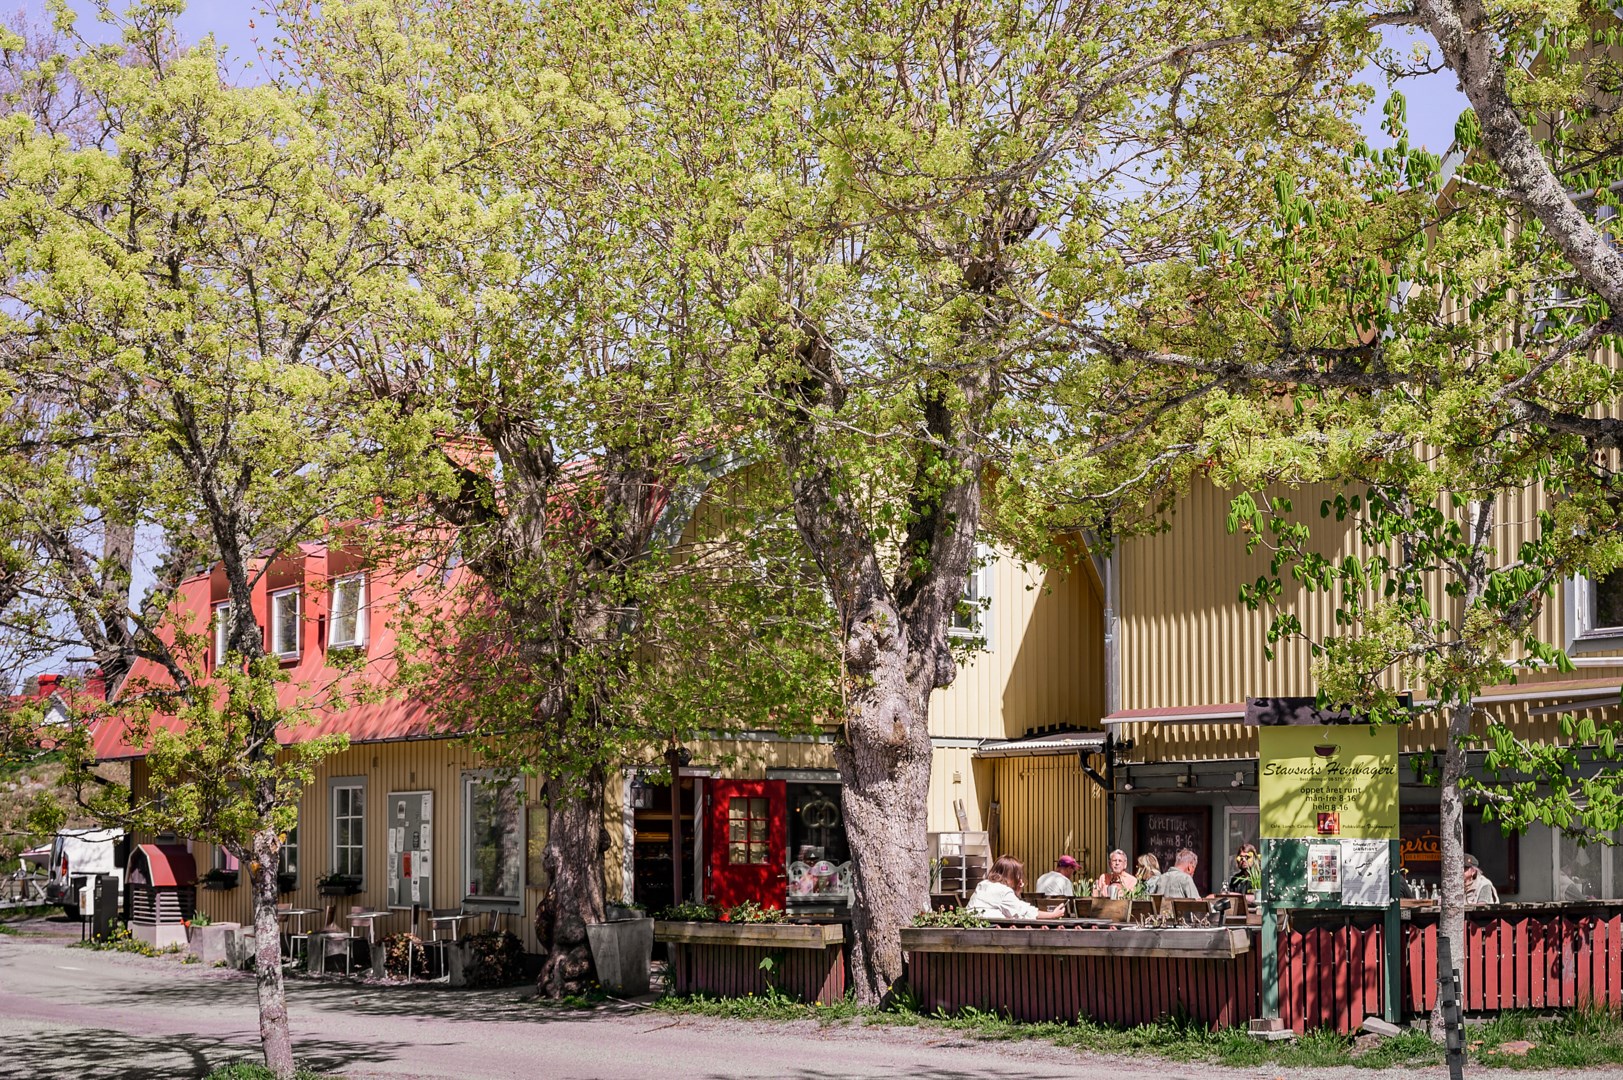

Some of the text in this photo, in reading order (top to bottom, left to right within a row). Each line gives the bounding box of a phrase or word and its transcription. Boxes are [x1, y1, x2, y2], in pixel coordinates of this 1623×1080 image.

[1263, 762, 1396, 779] Stavsnäs Hembageri
[1300, 786, 1323, 795] öppet
[1326, 785, 1342, 794] året
[1305, 794, 1337, 802] mån-fre
[1312, 803, 1330, 811] helg
